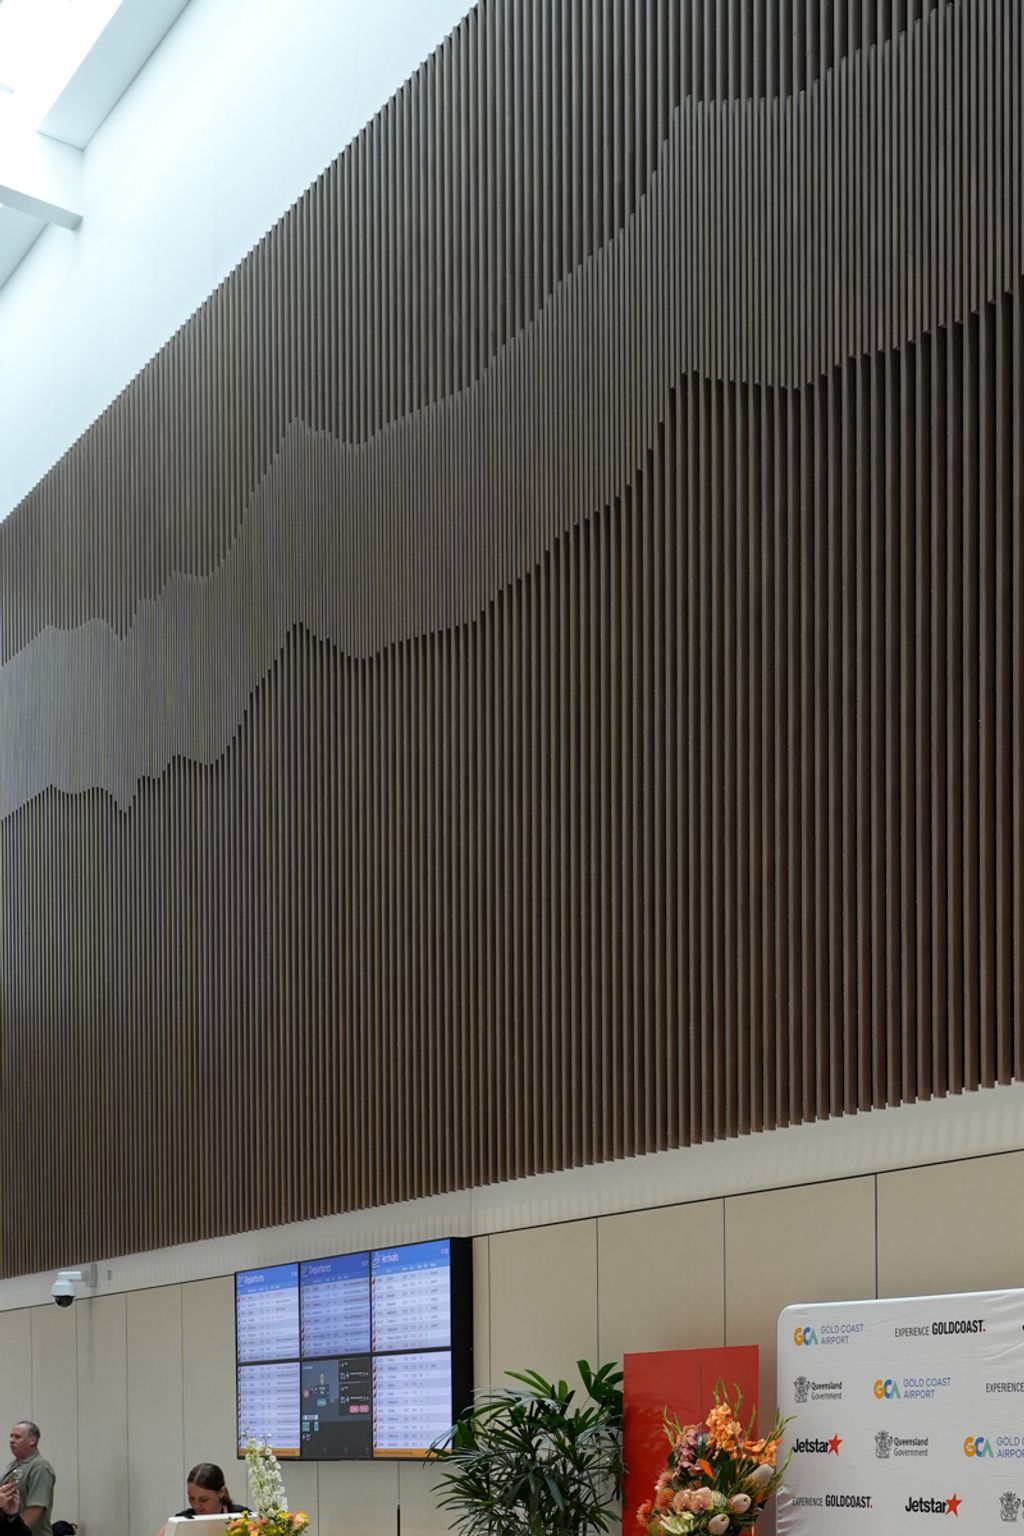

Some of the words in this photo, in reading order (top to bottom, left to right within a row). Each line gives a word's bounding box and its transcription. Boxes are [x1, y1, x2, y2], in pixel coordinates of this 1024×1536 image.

[820, 1324, 839, 1334] GOLD
[841, 1324, 864, 1333] COAST
[894, 1326, 929, 1338] EXPERIENCE
[794, 1327, 818, 1346] GCA
[820, 1336, 849, 1344] AIRPORT
[810, 1382, 842, 1390] Queensland
[903, 1378, 923, 1388] GOLD
[926, 1377, 952, 1387] COAST
[986, 1382, 1024, 1392] EXPERIENCE
[874, 1379, 900, 1400] GCA
[903, 1390, 935, 1399] AIRPORT
[810, 1392, 842, 1400] Government
[793, 1438, 829, 1454] Jetstar
[894, 1437, 928, 1447] Queensland
[996, 1436, 1019, 1446] GOLD
[894, 1448, 928, 1456] Government
[964, 1436, 994, 1458] GCA
[792, 1497, 823, 1506] EXPERIENCE
[905, 1496, 947, 1514] Jetstar
